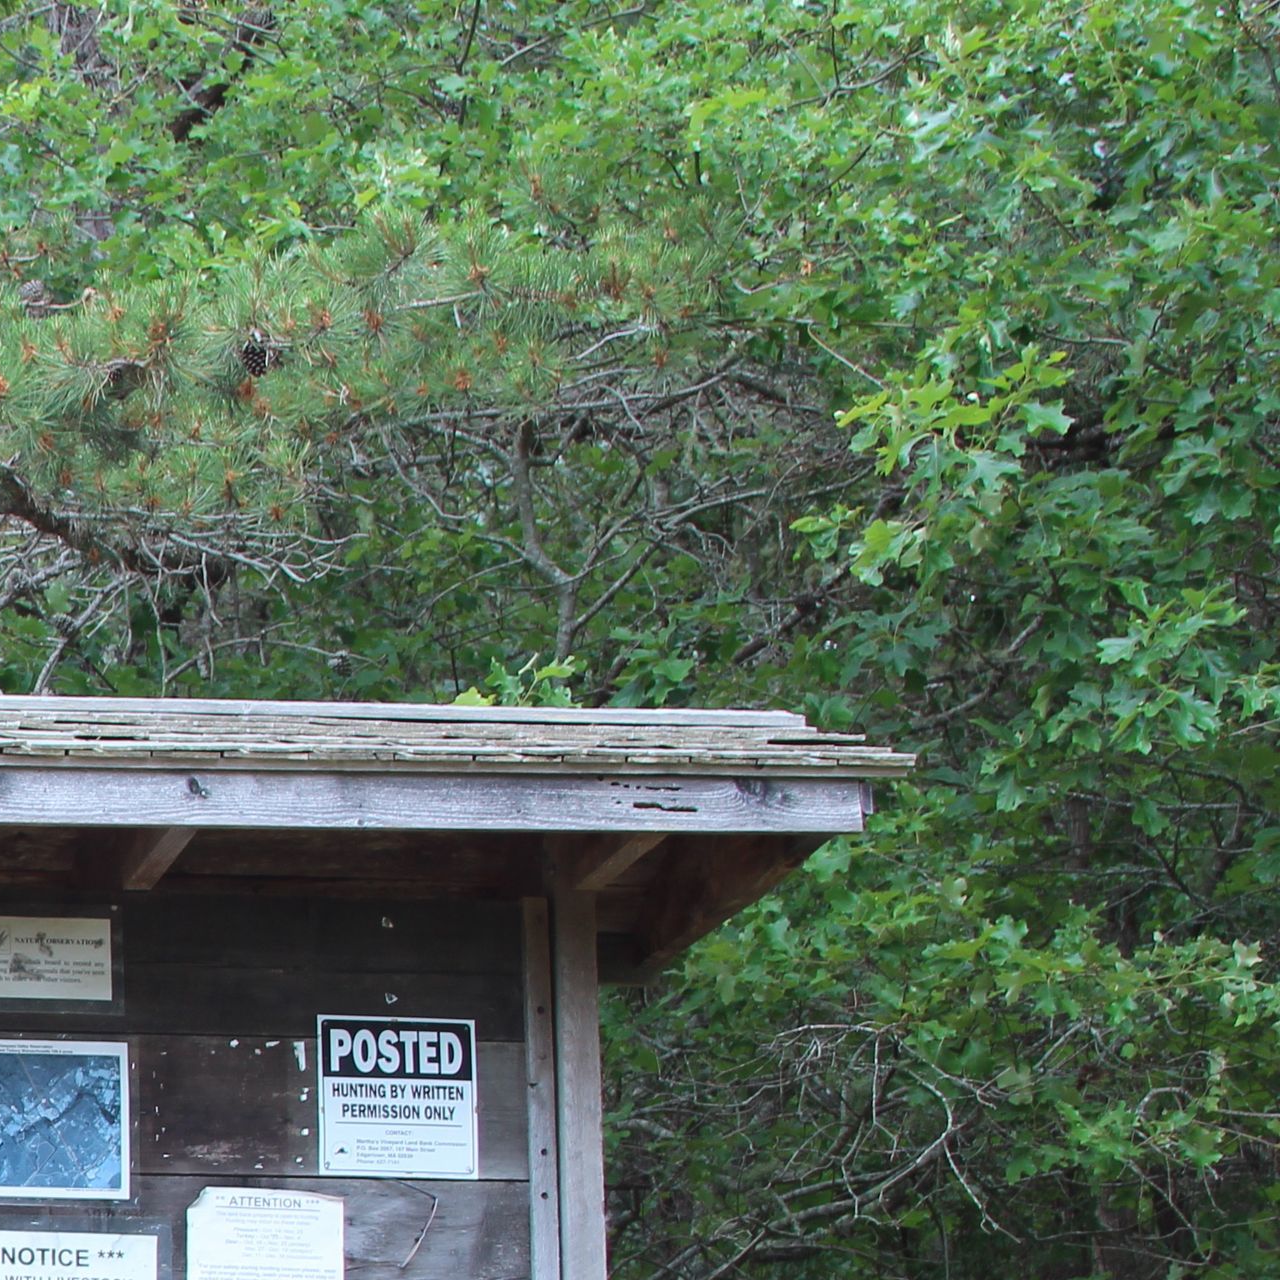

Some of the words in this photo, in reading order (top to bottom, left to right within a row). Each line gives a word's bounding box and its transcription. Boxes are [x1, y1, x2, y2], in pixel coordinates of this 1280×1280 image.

[46, 937, 103, 945] OBSERVATION
[330, 1029, 462, 1075] POSTED
[332, 1083, 386, 1098] HUNTING
[391, 1084, 406, 1098] BY
[410, 1085, 464, 1100] WRITTEN
[342, 1104, 420, 1119] PERMISSION
[424, 1106, 455, 1120] ONLY
[229, 1197, 301, 1208] ATTENTION
[1, 1248, 90, 1267] NOTICE
